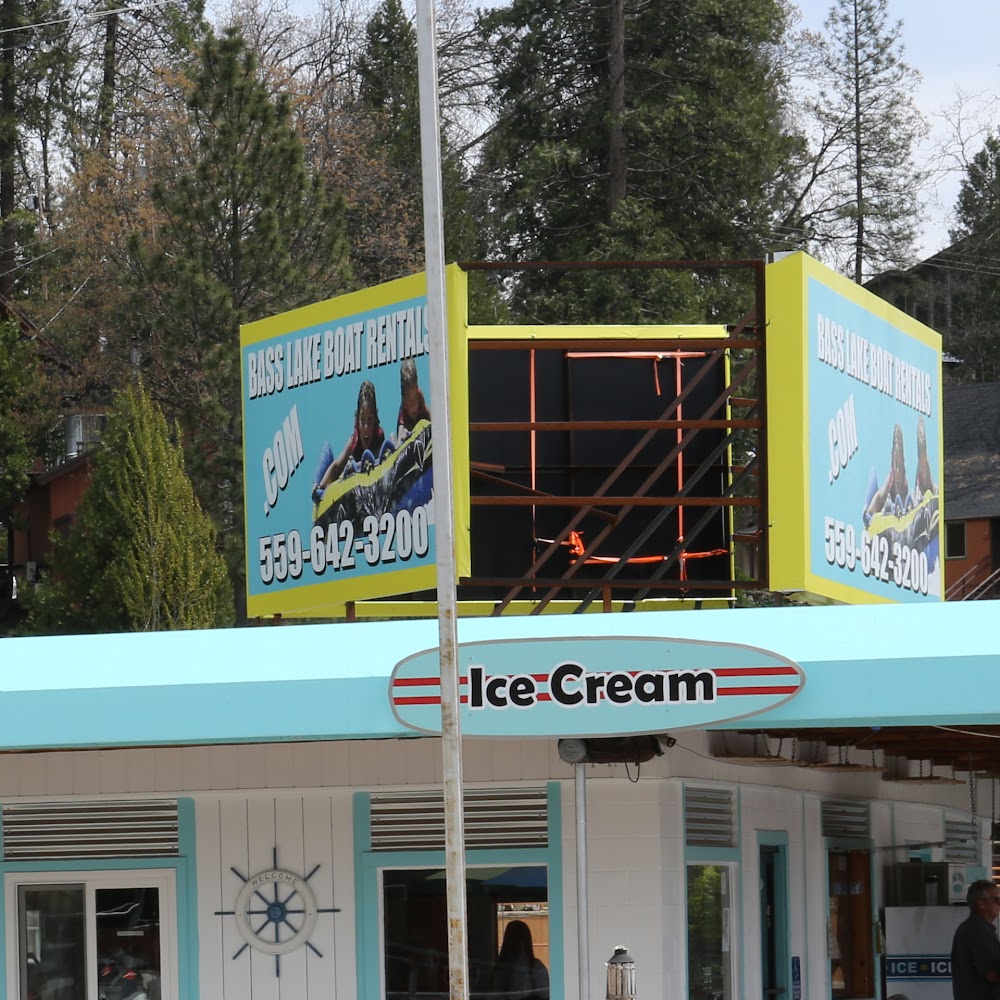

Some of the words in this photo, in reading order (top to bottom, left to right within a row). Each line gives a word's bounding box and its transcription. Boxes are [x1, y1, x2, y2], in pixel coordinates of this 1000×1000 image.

[248, 343, 284, 400] BASS
[287, 333, 322, 389] LAKE
[324, 321, 364, 379] BOAT
[818, 312, 845, 373] BASS
[846, 328, 869, 386] LAKE
[870, 342, 894, 397] BOAT
[895, 355, 931, 417] RENTALS
[262, 404, 304, 517] .COM
[259, 505, 429, 583] 559-642-3200
[824, 515, 929, 597] 559-642-3200
[469, 667, 537, 708] Ice
[550, 663, 714, 705] Cream
[252, 872, 298, 886] WELCOME
[891, 962, 918, 973] ICE
